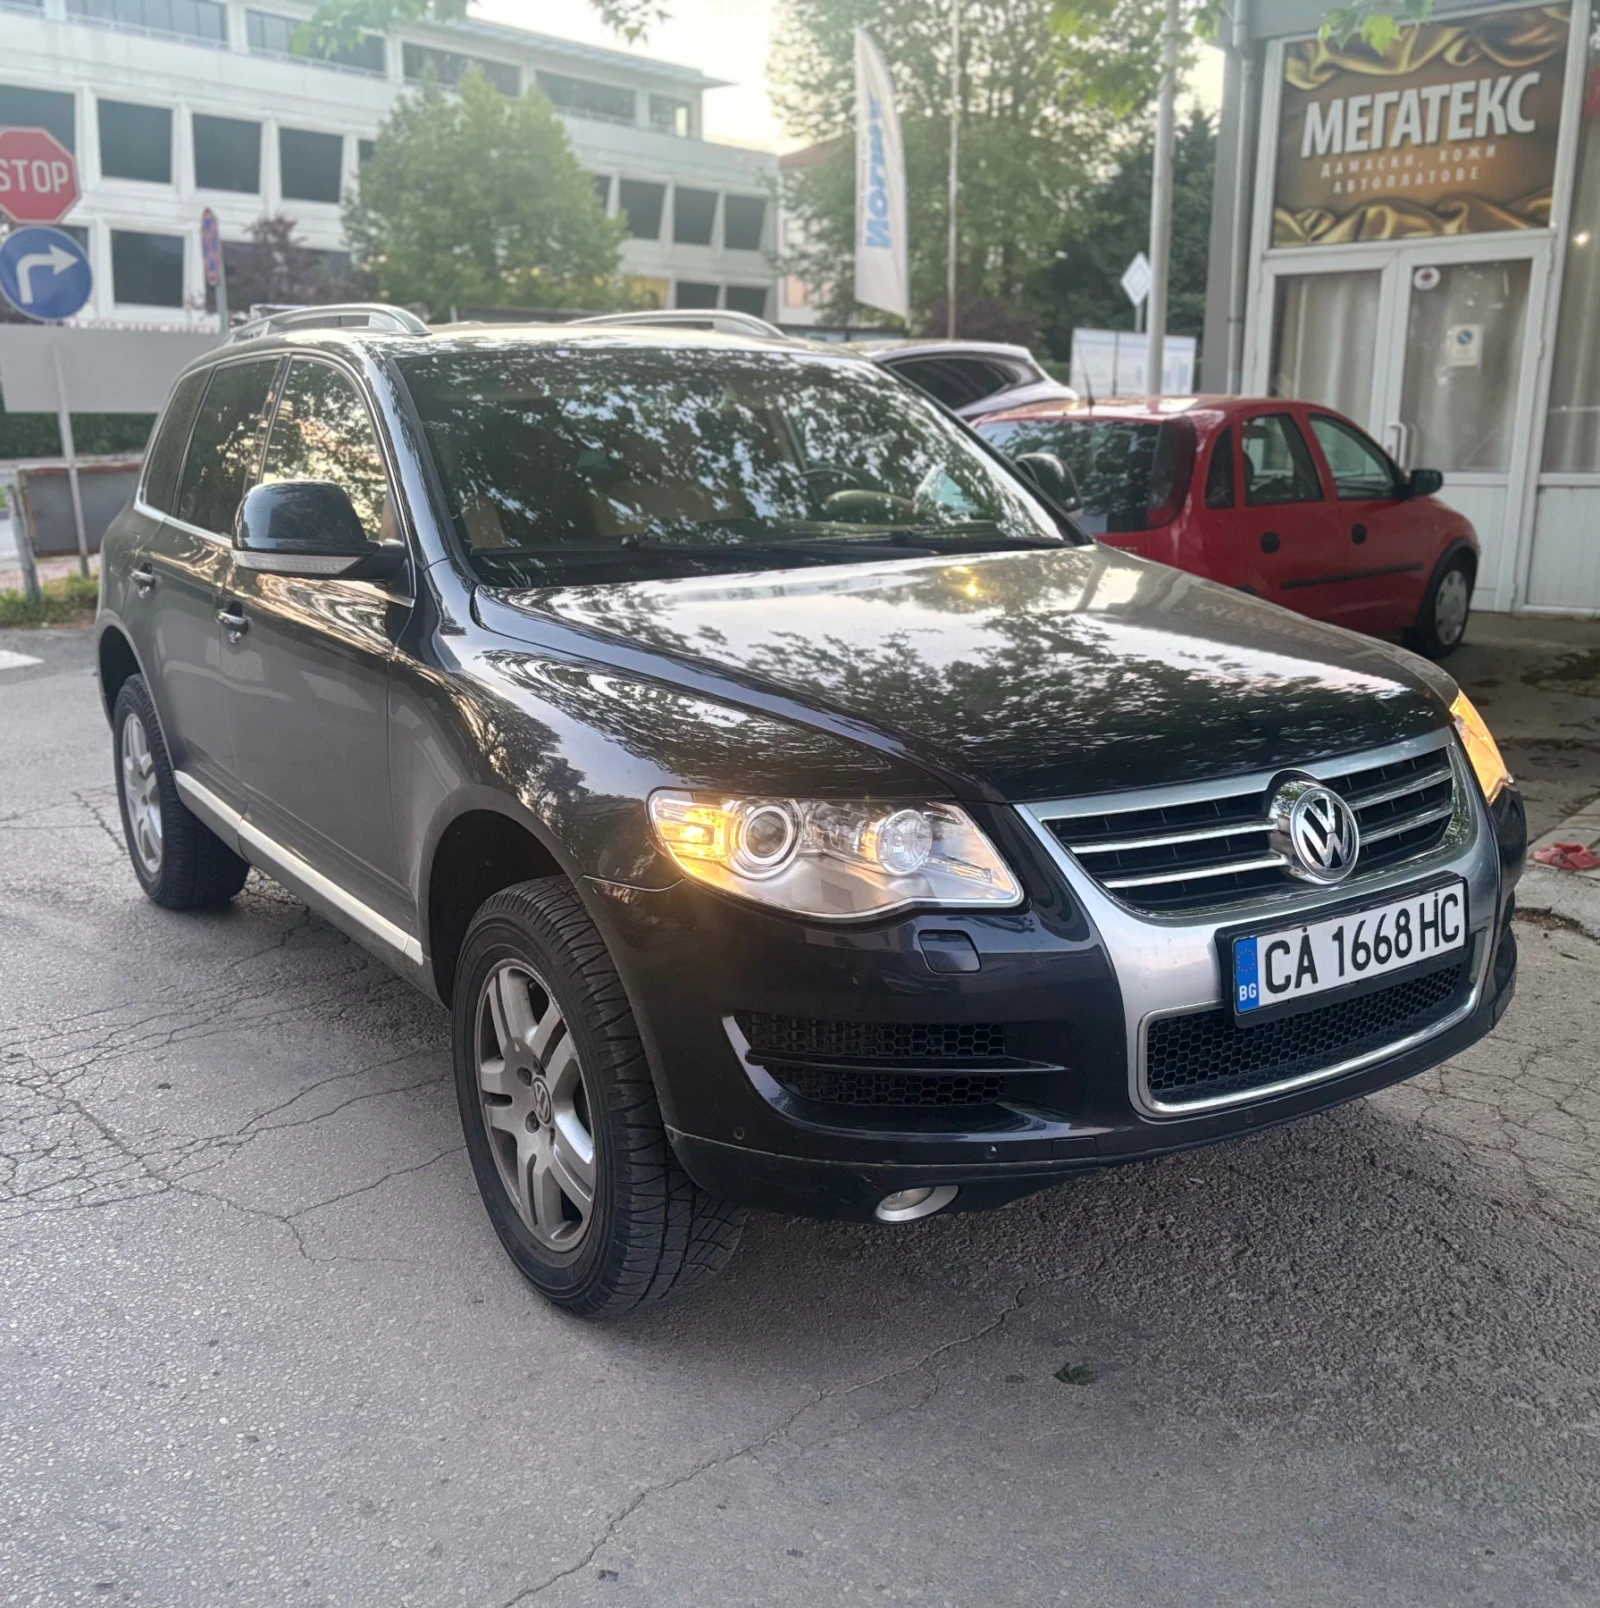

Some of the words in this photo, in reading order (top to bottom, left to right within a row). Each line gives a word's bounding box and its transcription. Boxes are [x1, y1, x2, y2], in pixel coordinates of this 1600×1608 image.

[1301, 72, 1541, 158] МЕГАТЕКС
[1439, 145, 1496, 164] КОЖИ
[0, 159, 69, 193] STOP
[1264, 932, 1319, 994] CA
[1332, 908, 1413, 977] 1668
[1420, 892, 1460, 952] HC
[1239, 983, 1257, 1001] BG
